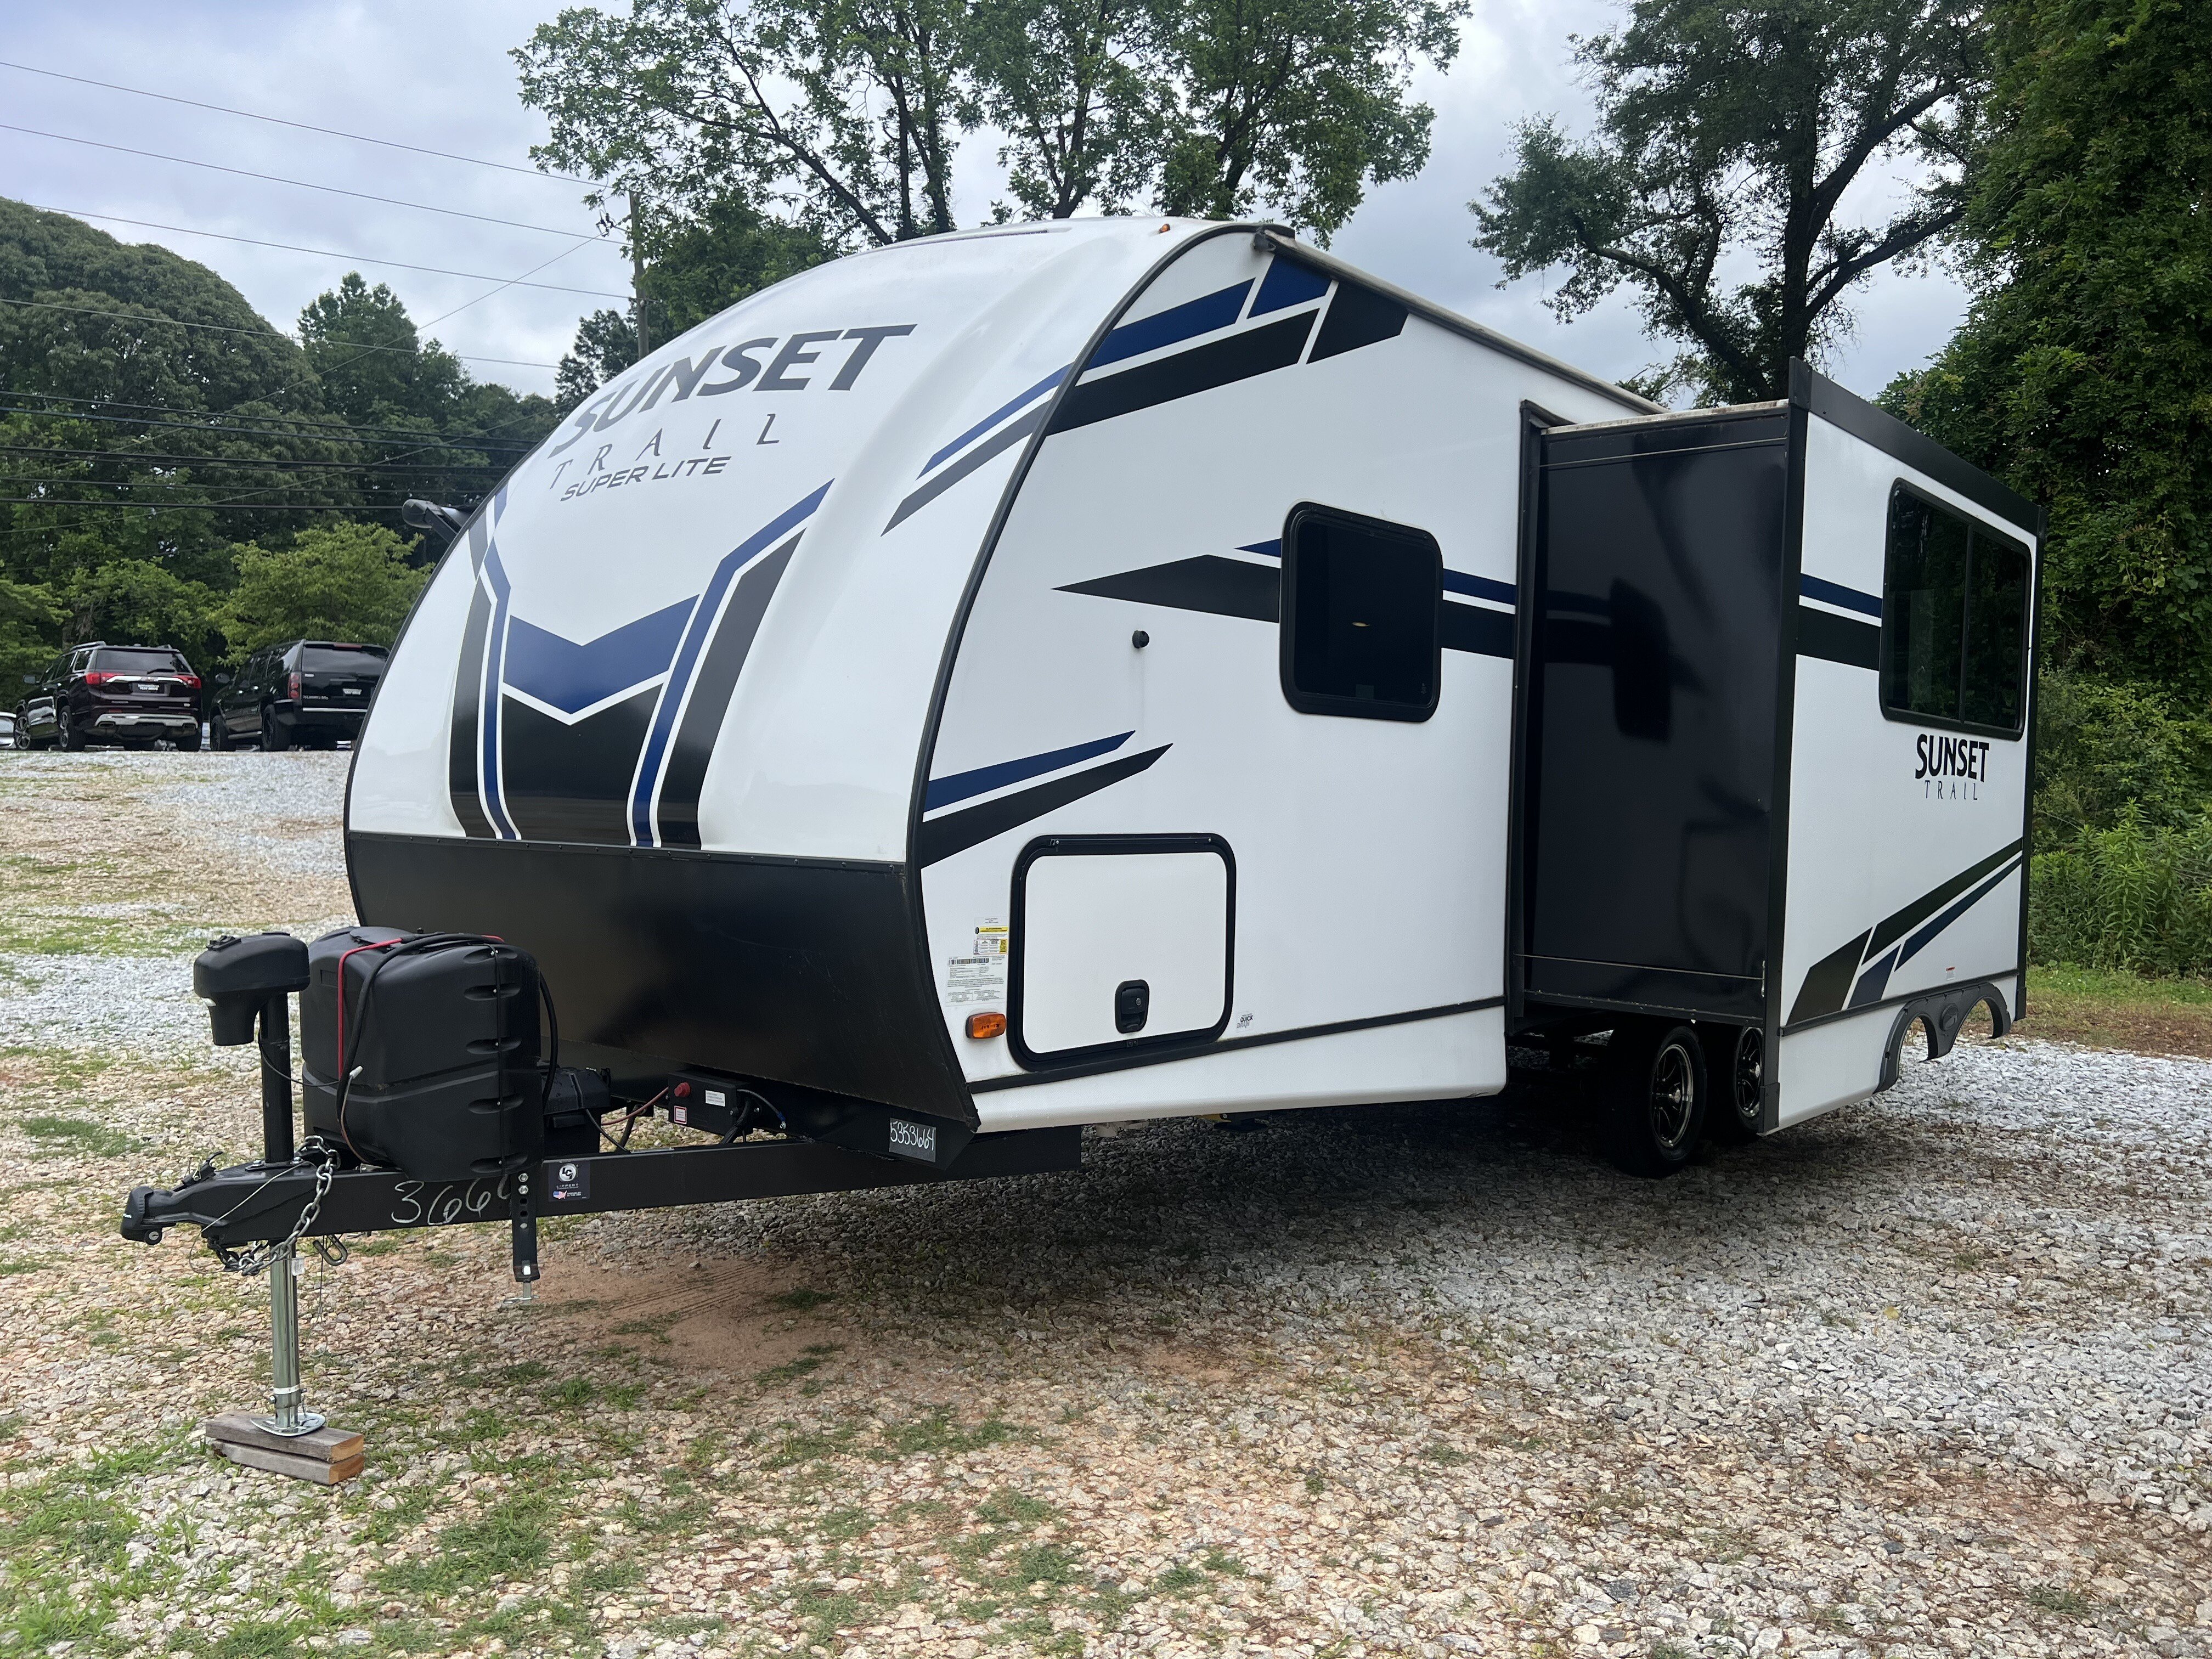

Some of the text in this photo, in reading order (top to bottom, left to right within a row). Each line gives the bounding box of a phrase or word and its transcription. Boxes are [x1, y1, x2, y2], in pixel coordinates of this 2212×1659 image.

[548, 324, 917, 459] SUNSET
[550, 414, 780, 489] TRAIL
[560, 456, 732, 501] SUPER LITE
[1915, 733, 1989, 782] SUNSET
[1925, 780, 1978, 800] TRAIL
[890, 1120, 934, 1151] 5353664
